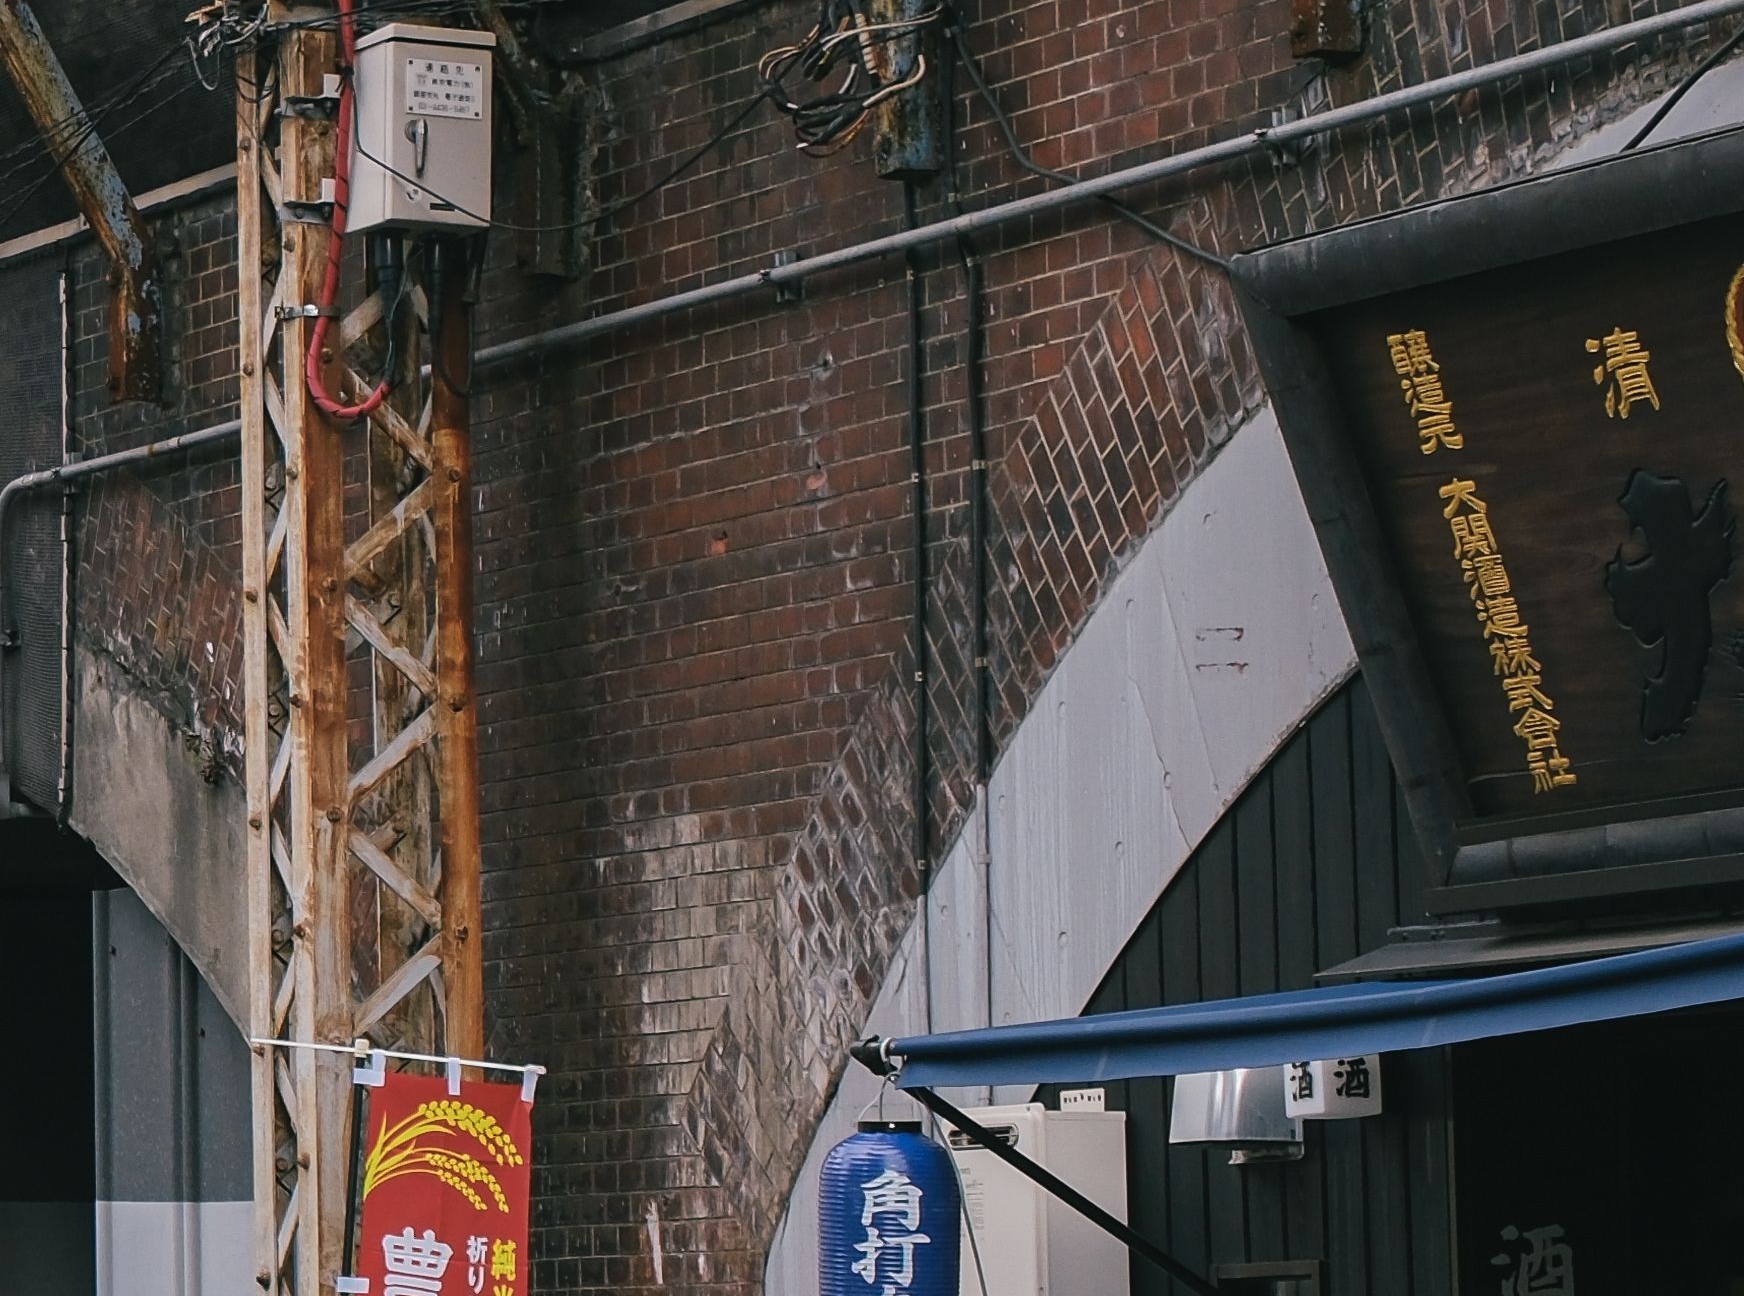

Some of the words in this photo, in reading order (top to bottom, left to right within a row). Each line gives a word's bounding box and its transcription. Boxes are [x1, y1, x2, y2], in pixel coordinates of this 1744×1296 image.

[1584, 325, 1661, 420] 清
[1289, 1060, 1314, 1102] 酒
[1333, 1057, 1370, 1099] 酒
